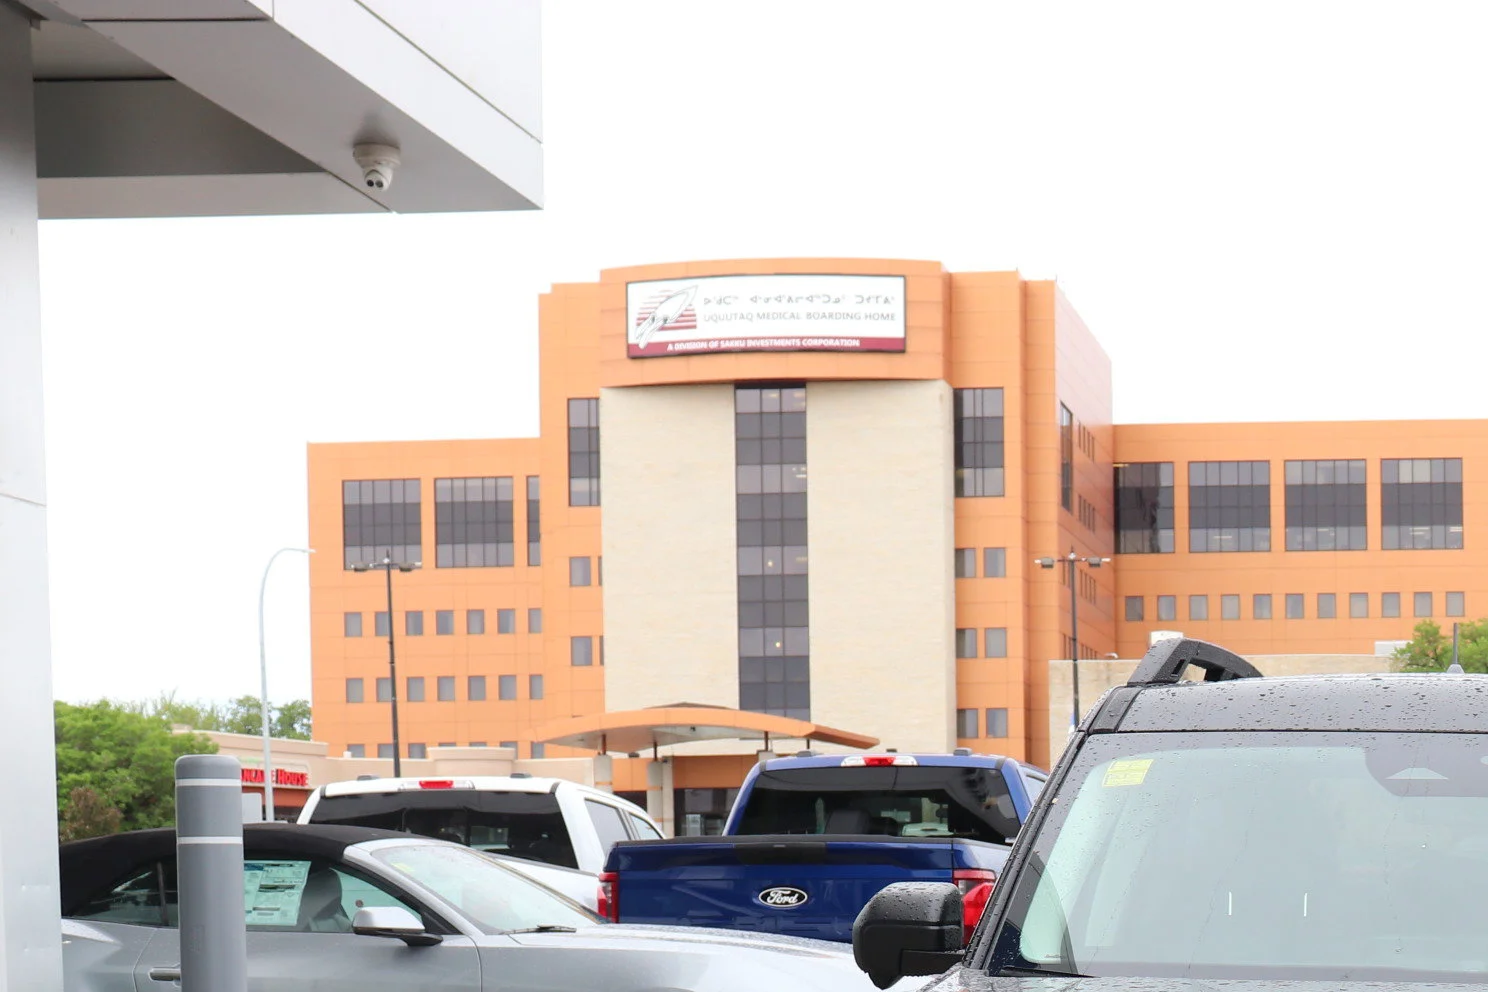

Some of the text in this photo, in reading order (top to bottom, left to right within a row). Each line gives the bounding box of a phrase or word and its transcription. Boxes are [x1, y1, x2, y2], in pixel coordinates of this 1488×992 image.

[756, 311, 802, 321] MEDICAL
[806, 311, 862, 321] BOARDING
[864, 312, 896, 321] HOME
[666, 338, 860, 351] A DIVISION OF SAKKU INVESTMENTS CORPORATION
[766, 890, 799, 904] Ford
